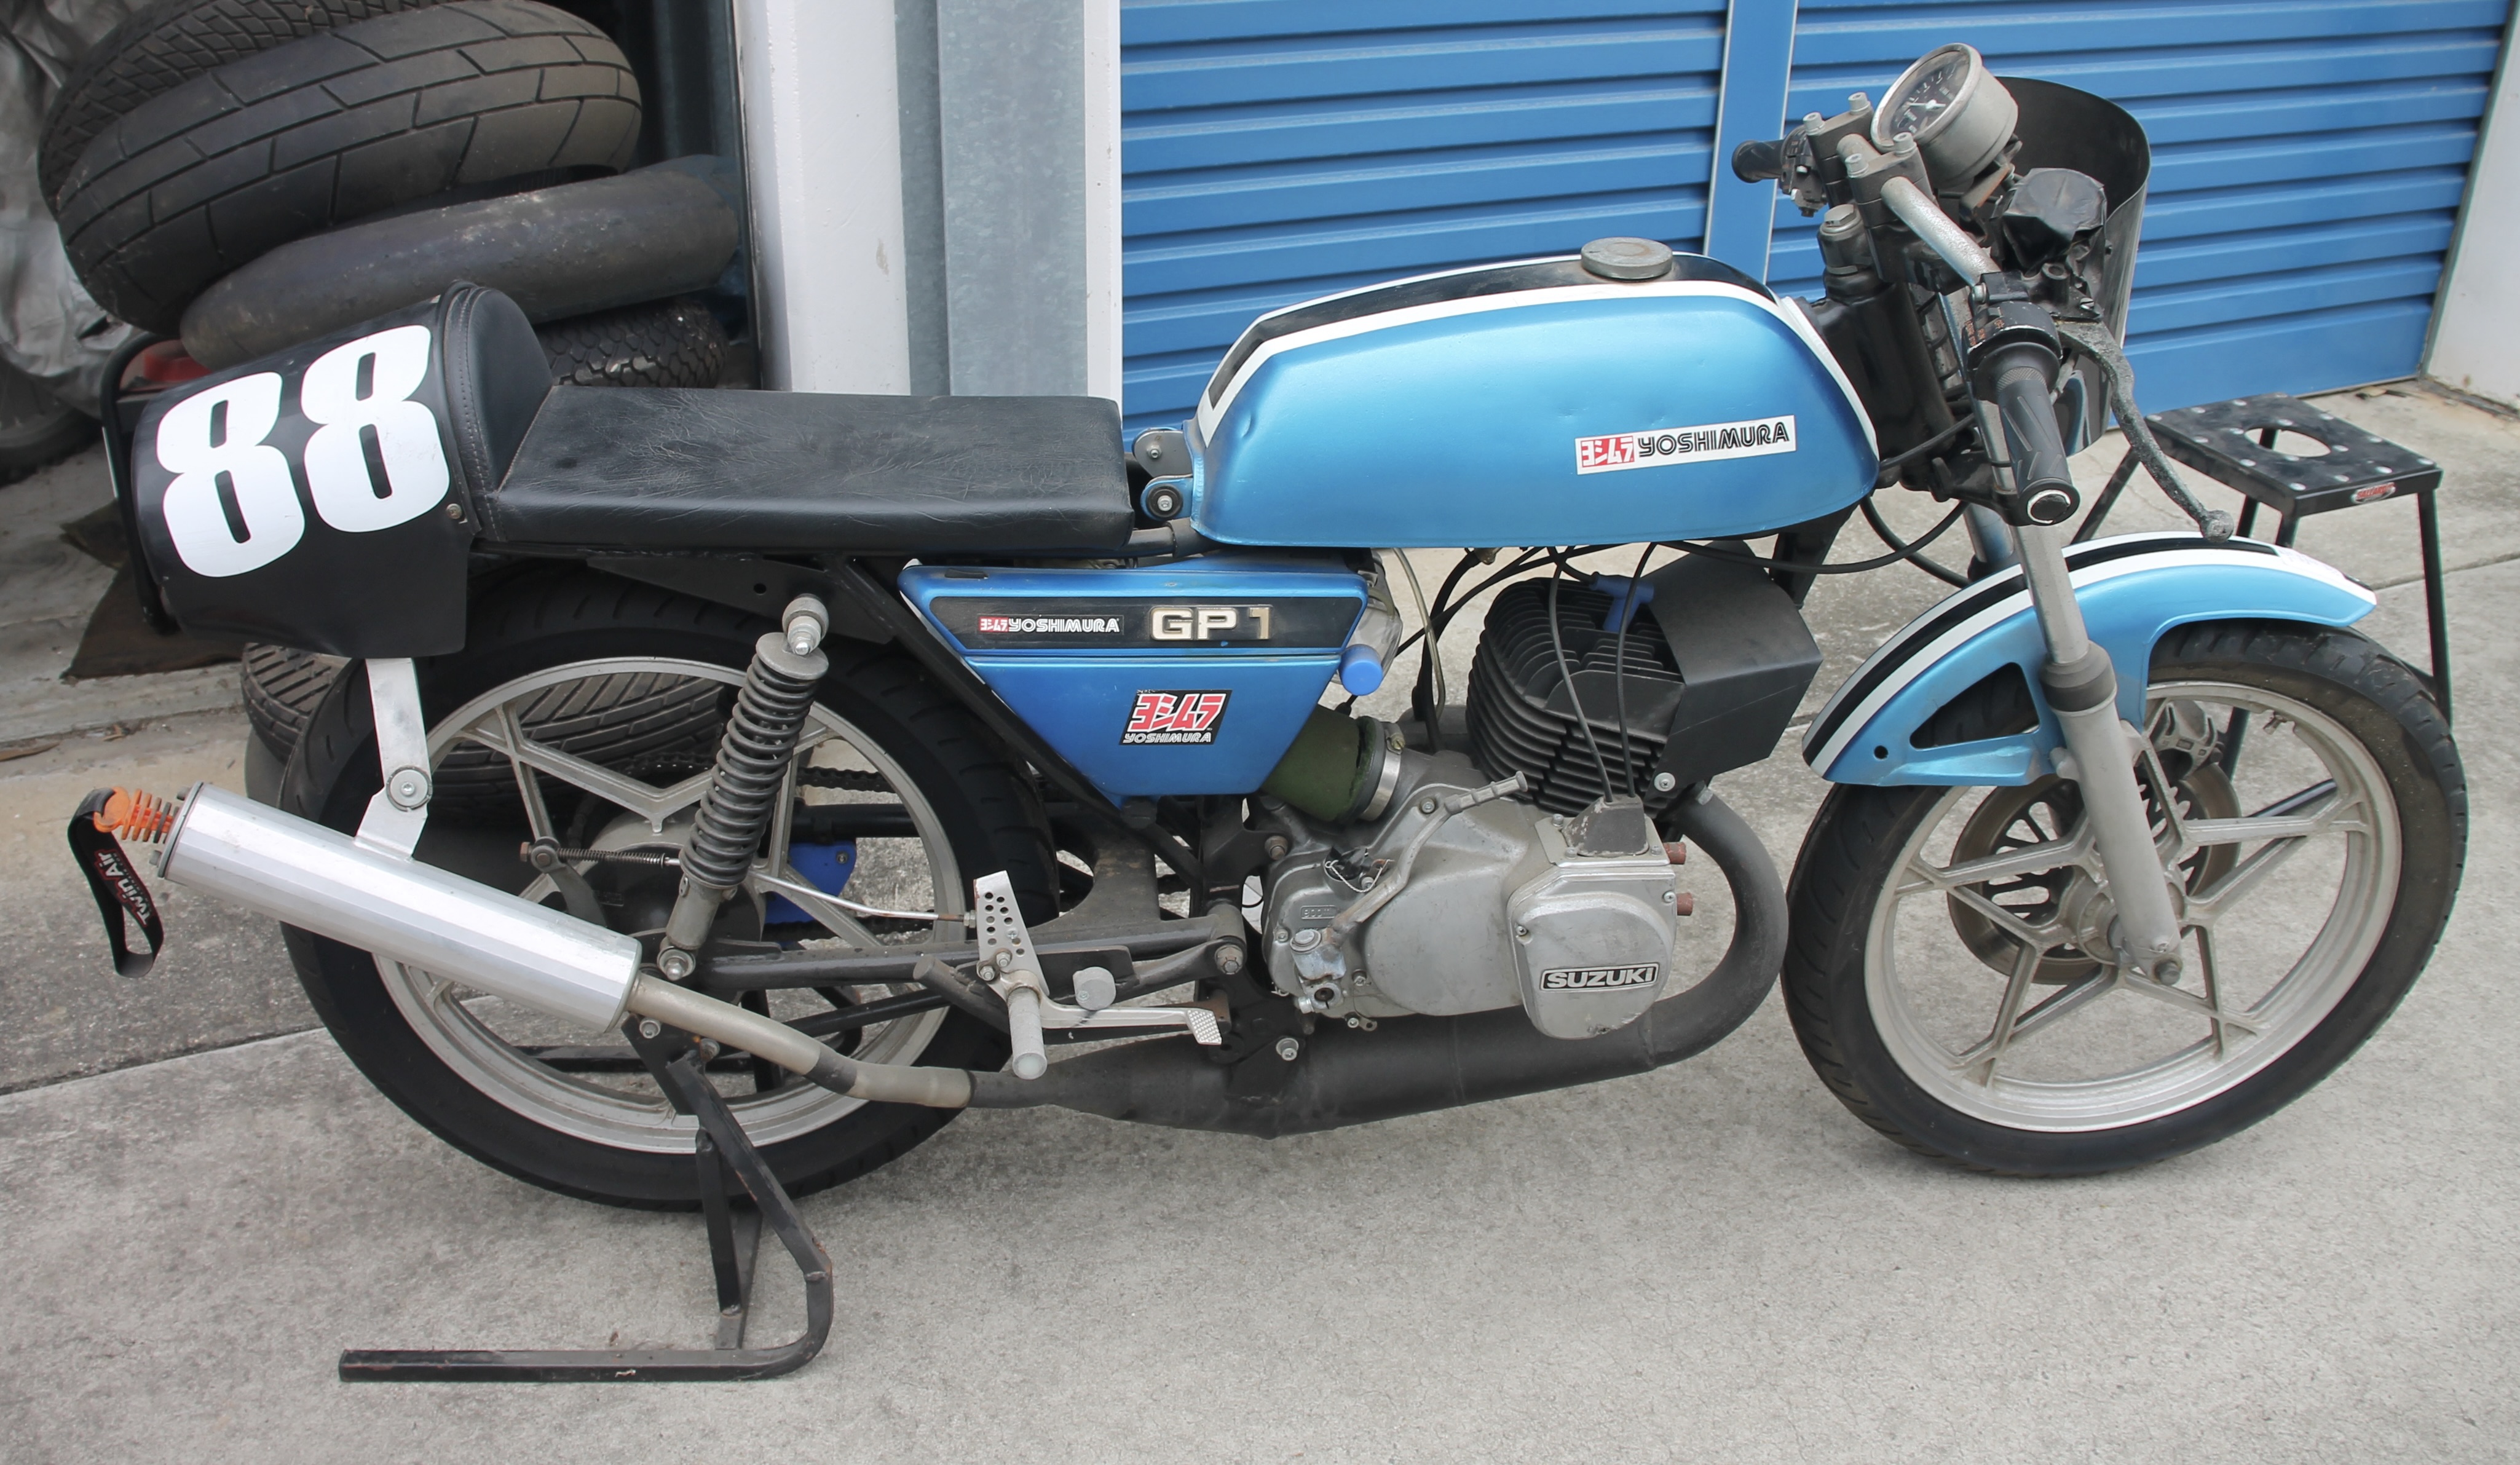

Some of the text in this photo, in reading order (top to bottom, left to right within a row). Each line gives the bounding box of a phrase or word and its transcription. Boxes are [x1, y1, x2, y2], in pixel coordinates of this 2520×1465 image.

[156, 324, 450, 578] 88
[1581, 422, 1790, 467] ヨシムラ YOSHIMURA
[1008, 618, 1120, 633] YOSHIMURA
[1151, 607, 1237, 641] GP
[1127, 693, 1227, 733] ヨシムラ
[1123, 732, 1212, 744] YOSHIMURA
[98, 853, 151, 925] Twin Air
[1546, 967, 1654, 988] SUZUKI
